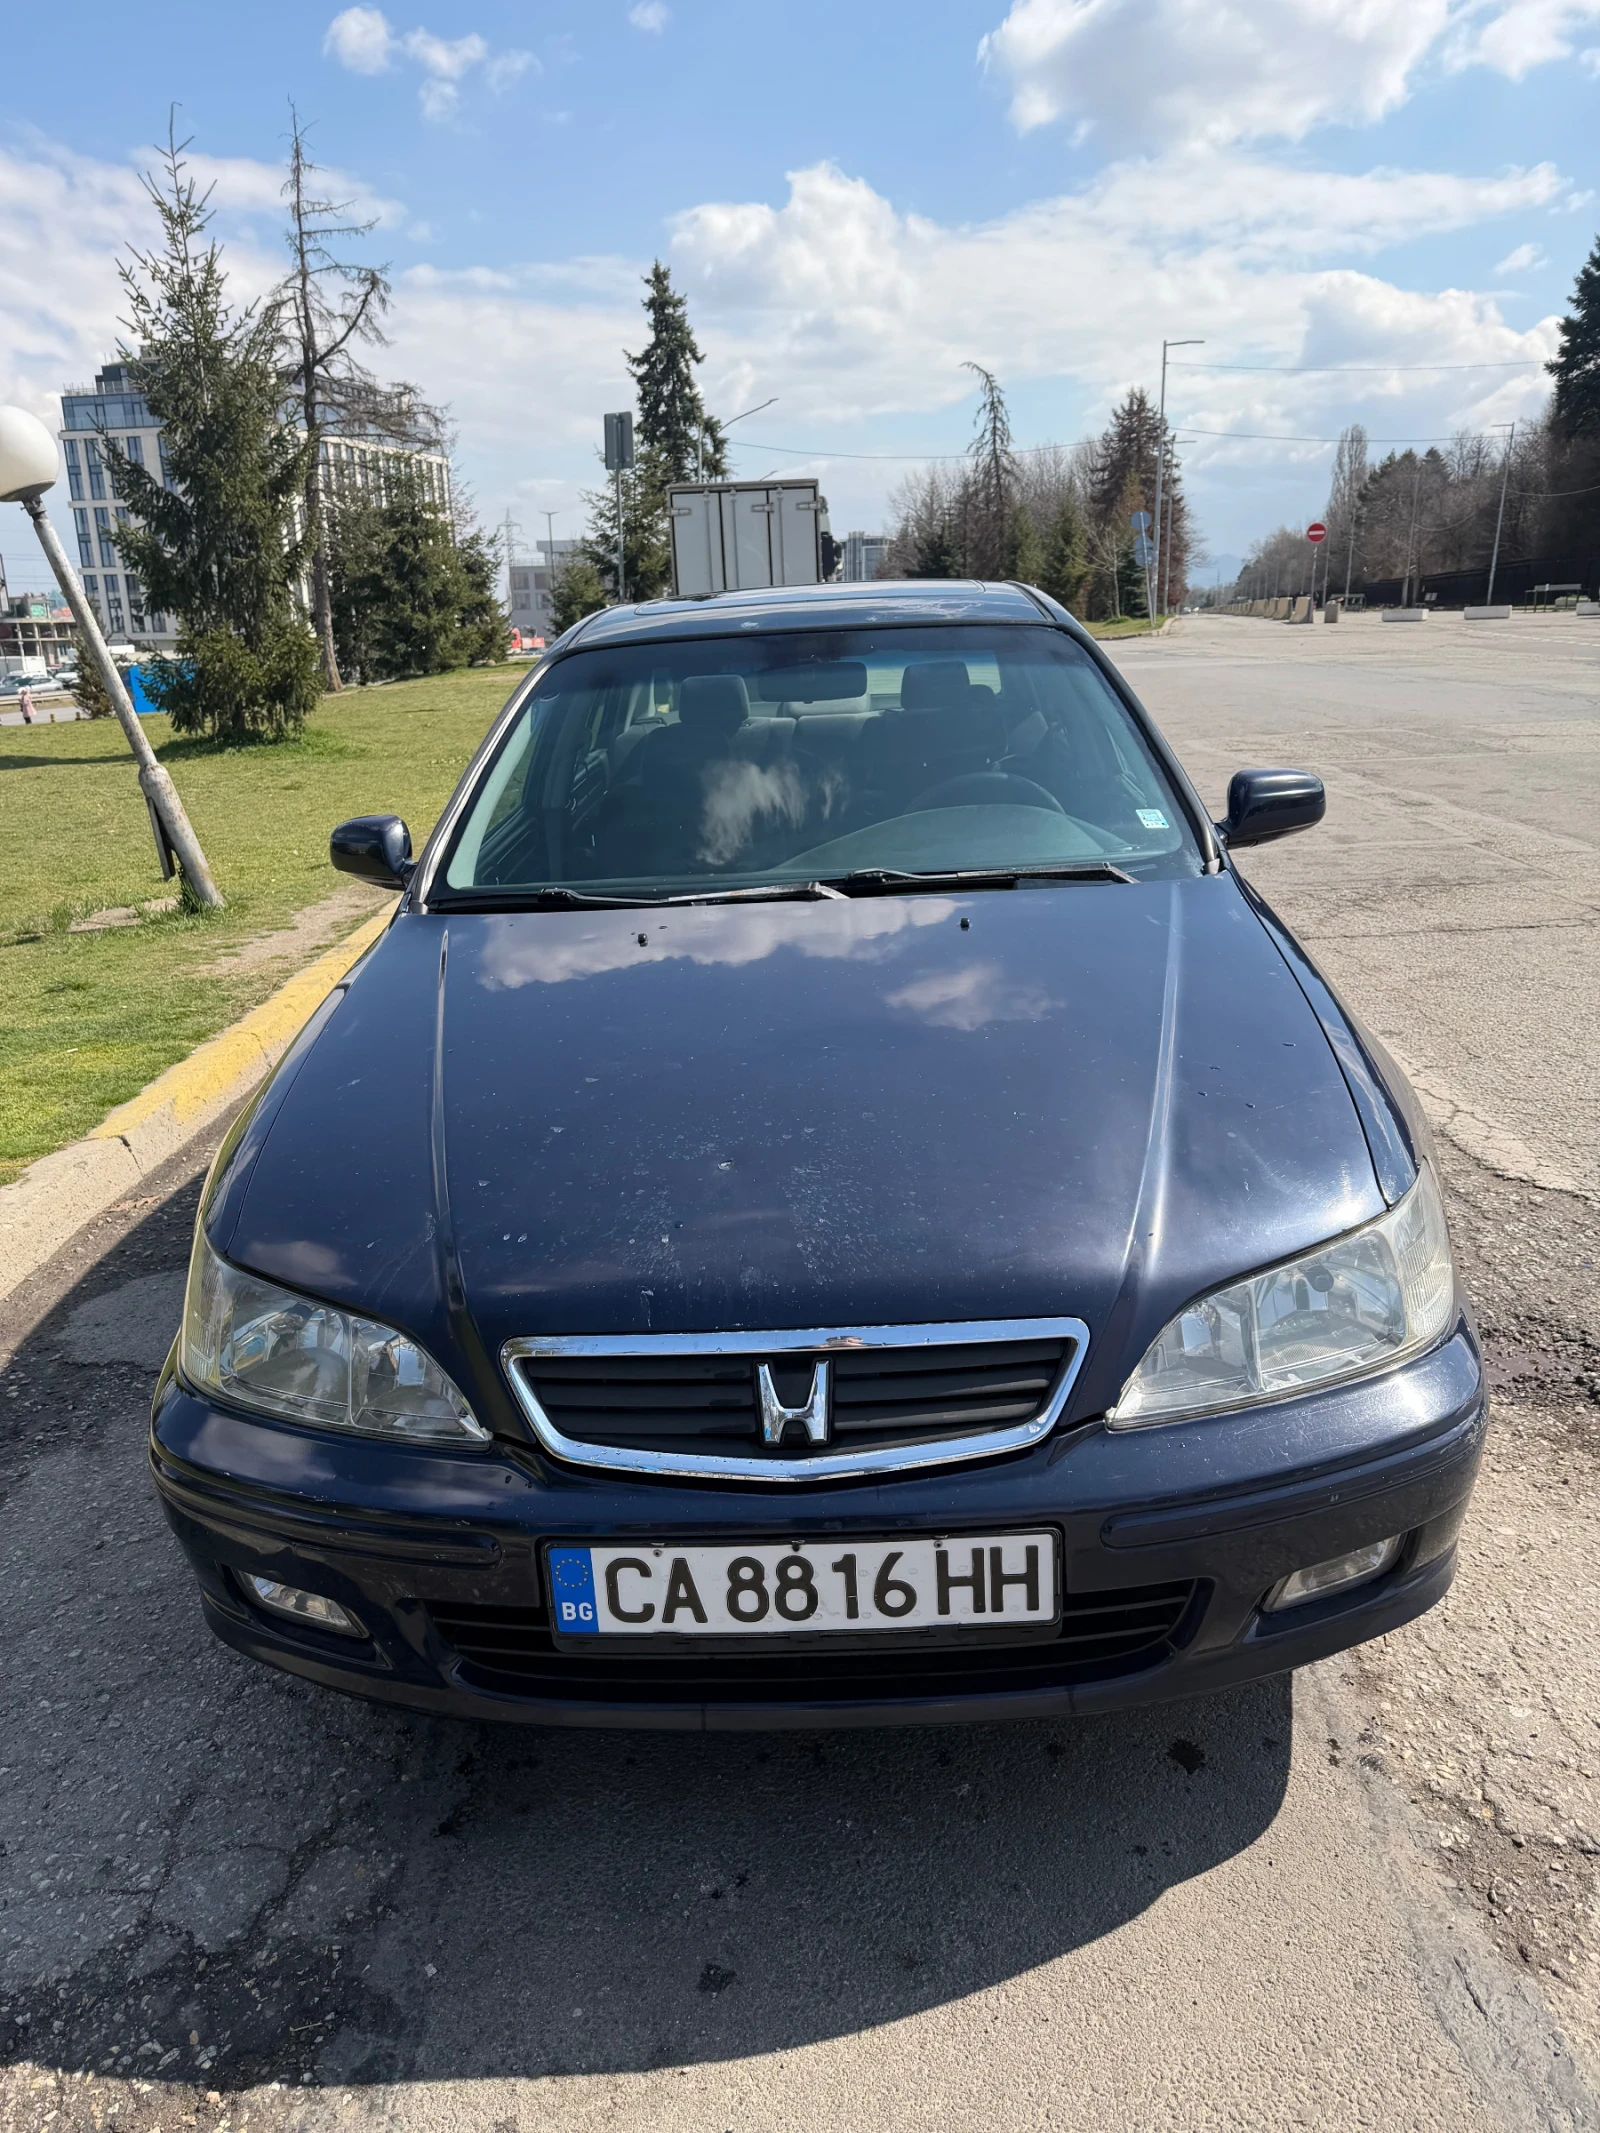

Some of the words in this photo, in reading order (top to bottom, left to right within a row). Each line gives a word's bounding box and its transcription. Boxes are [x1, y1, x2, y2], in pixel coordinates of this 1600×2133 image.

[757, 1359, 830, 1445] H
[562, 1601, 593, 1622] BG
[605, 1557, 708, 1623] CA
[726, 1551, 917, 1622] 8816
[935, 1544, 1040, 1615] HH
